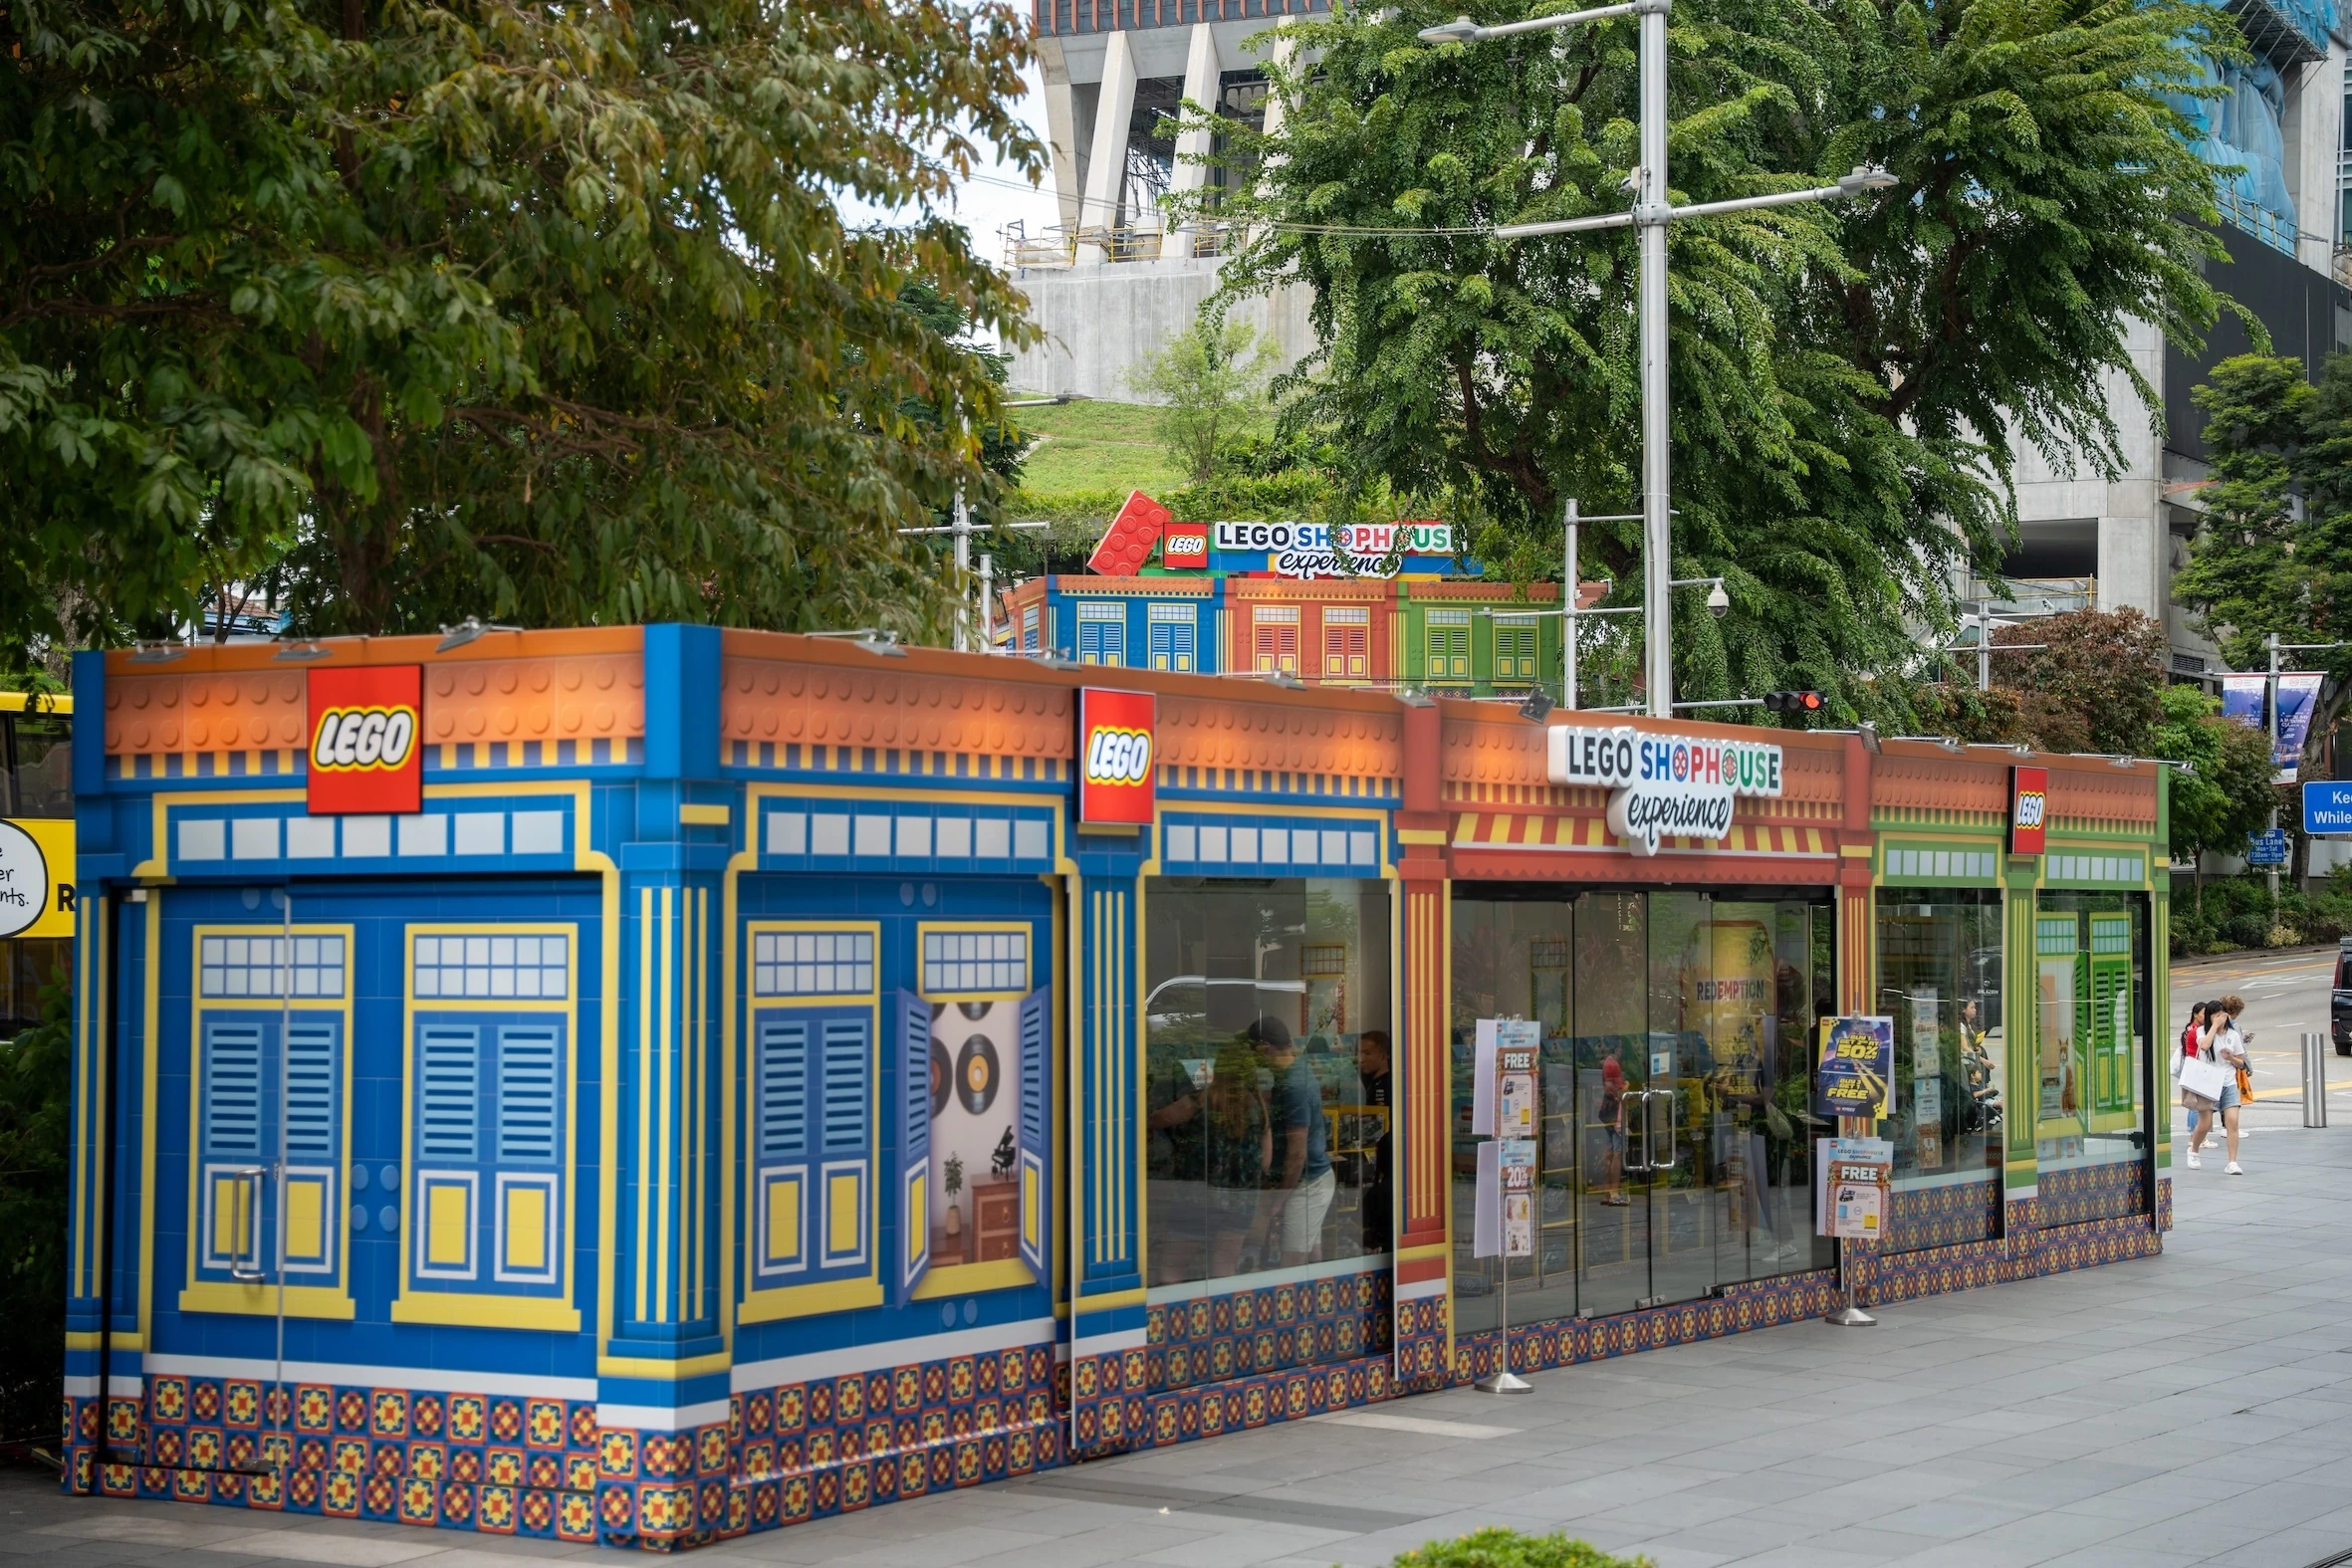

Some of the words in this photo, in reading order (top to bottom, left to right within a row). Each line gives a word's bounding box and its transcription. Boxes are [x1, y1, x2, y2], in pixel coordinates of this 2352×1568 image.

[1167, 536, 1204, 555] LEGO
[314, 710, 414, 769] LEGO
[1087, 732, 1149, 782] LEGO
[1568, 735, 1633, 779] LEGO
[1640, 741, 1779, 789] SHOPHOUSE
[2332, 790, 2352, 804] Ke
[1627, 792, 1731, 847] experience
[2015, 794, 2045, 829] LEGO
[1697, 979, 1764, 1002] REDEMPTION
[1505, 1052, 1530, 1068] FREE
[1836, 1043, 1879, 1059] 50%
[1826, 1087, 1869, 1100] FREE
[1507, 1166, 1529, 1188] 20%
[1840, 1165, 1878, 1181] FREE
